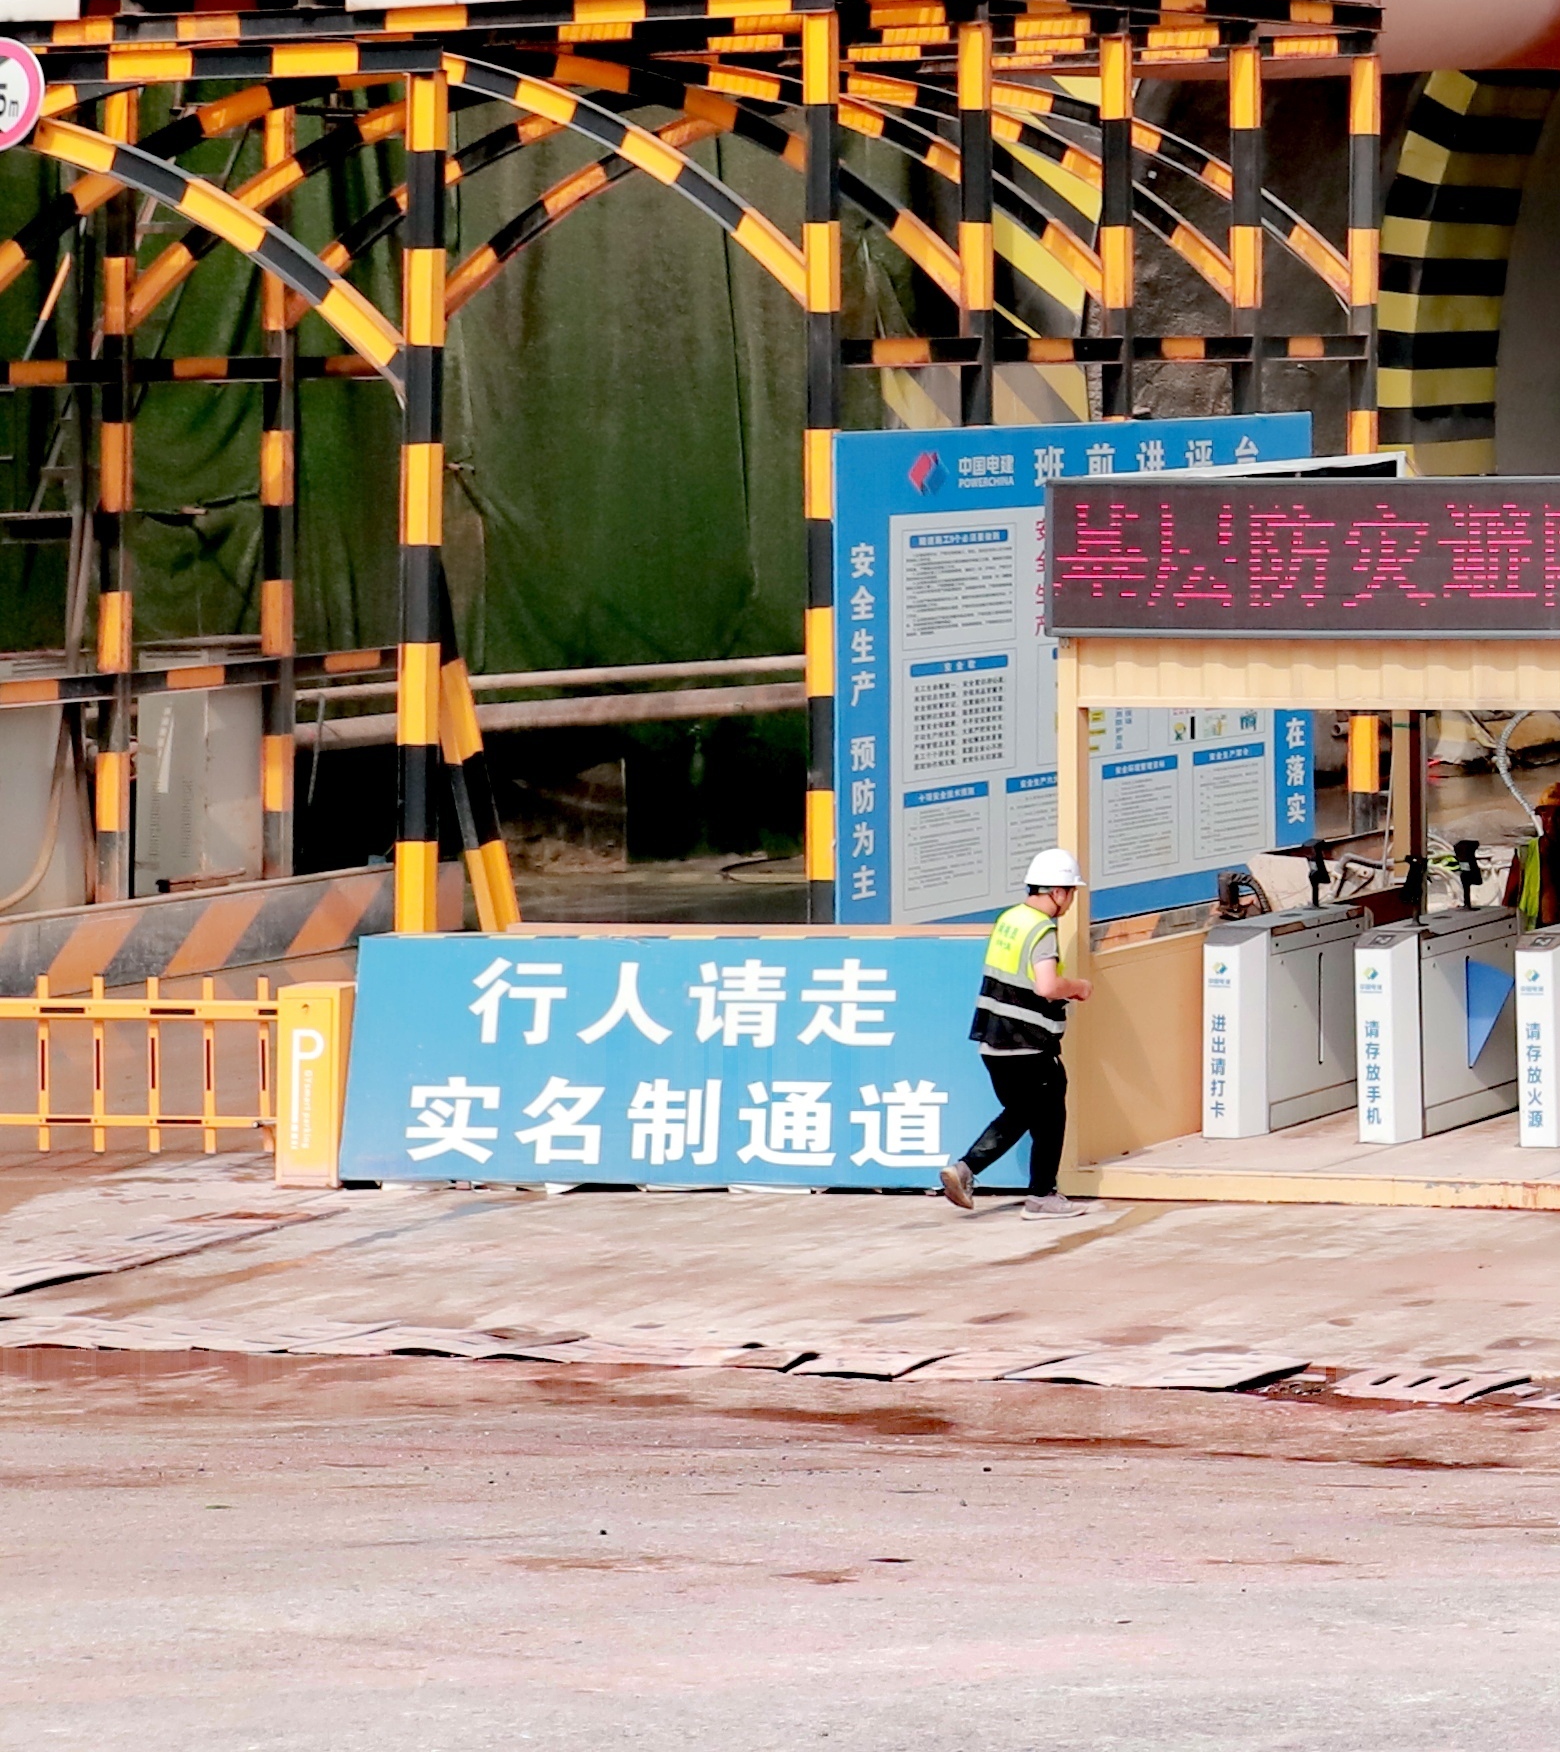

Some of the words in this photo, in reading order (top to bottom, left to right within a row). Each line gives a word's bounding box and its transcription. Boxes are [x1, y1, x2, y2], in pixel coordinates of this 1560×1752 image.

[958, 454, 1015, 476] 中国电建
[850, 542, 876, 707] 安全生产
[850, 735, 877, 901] 预防为主
[1285, 710, 1307, 825] 在落实
[469, 957, 898, 1048] 行人请走
[1210, 1014, 1227, 1118] 进出请打卡
[1364, 1020, 1382, 1125] 请存放手机
[1525, 1022, 1544, 1128] 请存放火源
[405, 1076, 951, 1169] 实名制通道
